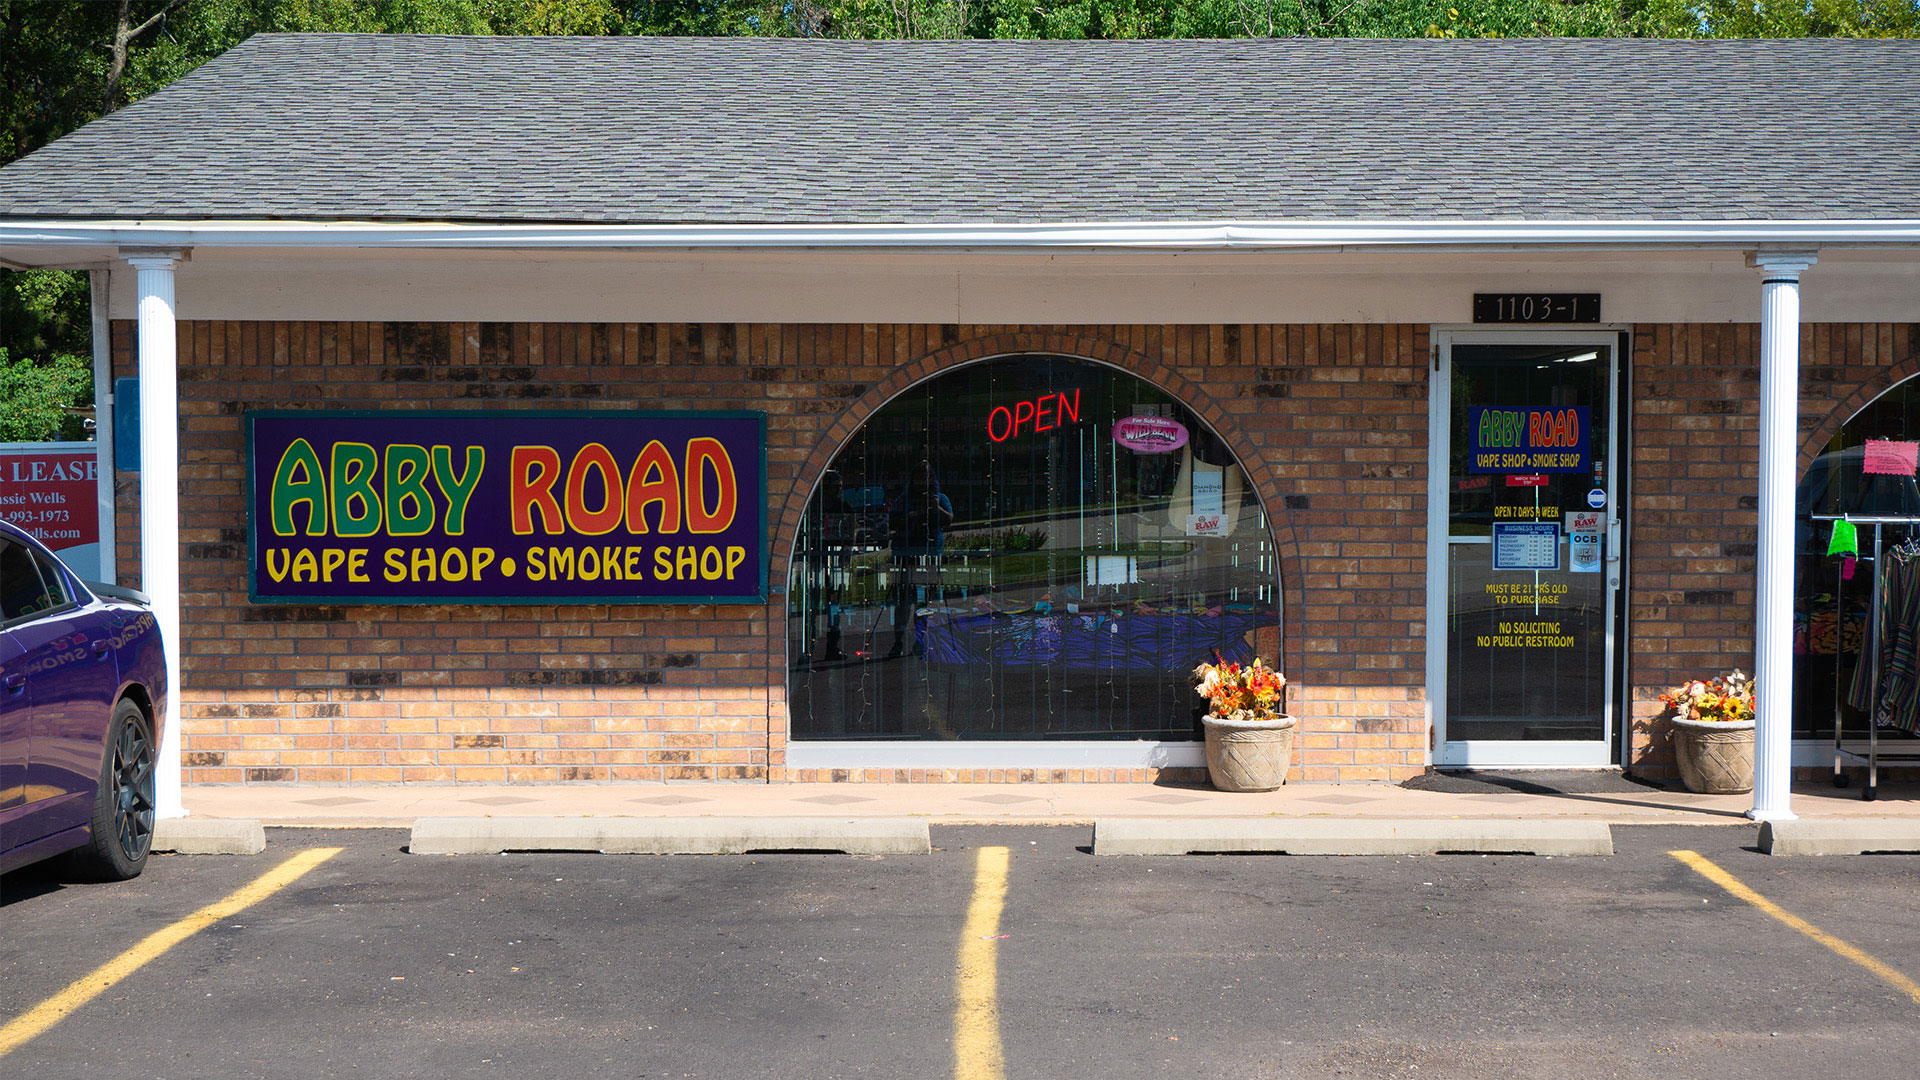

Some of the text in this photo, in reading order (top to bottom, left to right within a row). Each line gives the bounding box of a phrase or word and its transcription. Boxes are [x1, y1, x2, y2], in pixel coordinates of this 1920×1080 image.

[1497, 296, 1578, 320] 1103-1
[988, 388, 1080, 442] OPEN
[1121, 423, 1179, 442] WILD BERRY
[1478, 408, 1579, 447] ABBY ROAD
[1477, 453, 1580, 468] VAPE SHOP SMOKE SHOP
[10, 460, 98, 482] LEASE
[271, 437, 737, 537] ABBY ROAD
[1458, 477, 1489, 490] RAW
[29, 491, 66, 504] Wells
[1494, 506, 1559, 518] OPEN 7 DAYS A WEEK
[1195, 520, 1218, 530] RAW
[1574, 517, 1598, 528] RAW
[26, 527, 80, 539] ells.com
[1574, 535, 1598, 543] OCB
[266, 545, 746, 583] VAPE SHOP SMOKE SHOP
[1485, 584, 1509, 593] MUST
[1510, 584, 1521, 593] BE
[1522, 584, 1532, 593] 21
[1551, 584, 1568, 593] OLD
[1495, 595, 1560, 604] TO PURCHASE
[1499, 622, 1561, 634] NO SOLICITING
[1477, 635, 1575, 647] NO PUBLIC RESTROOM
